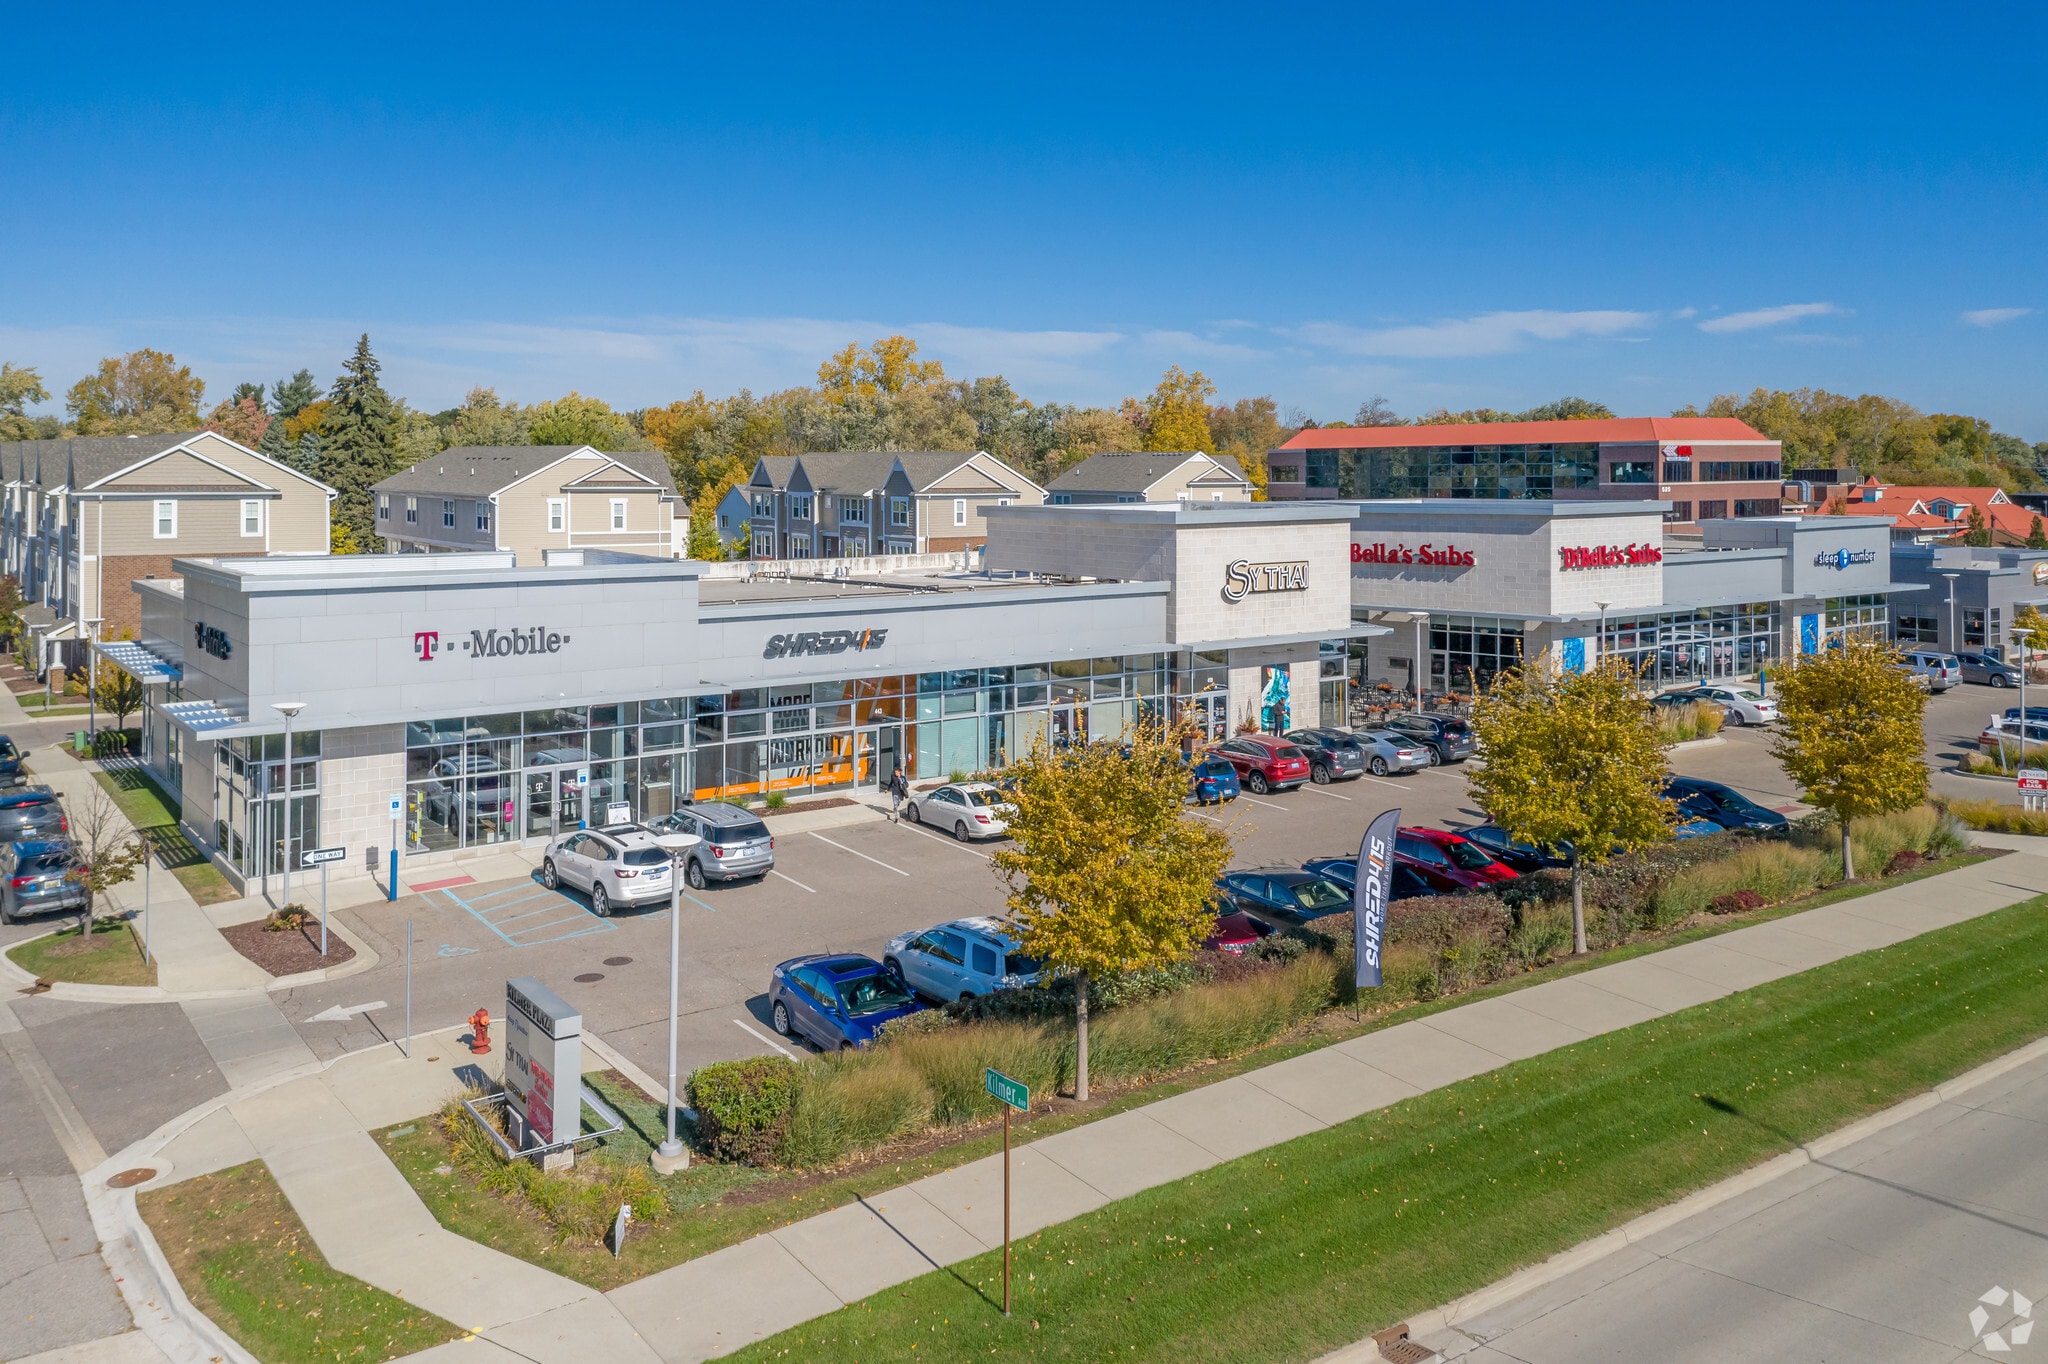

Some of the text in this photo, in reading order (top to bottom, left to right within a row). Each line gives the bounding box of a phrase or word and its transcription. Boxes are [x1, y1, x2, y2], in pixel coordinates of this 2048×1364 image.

[1418, 543, 1476, 567] Subs
[1561, 542, 1662, 569] DiBella's Subs
[1817, 549, 1876, 567] sleep number
[1264, 564, 1309, 590] THAI
[988, 1072, 1016, 1103] Kilmer
